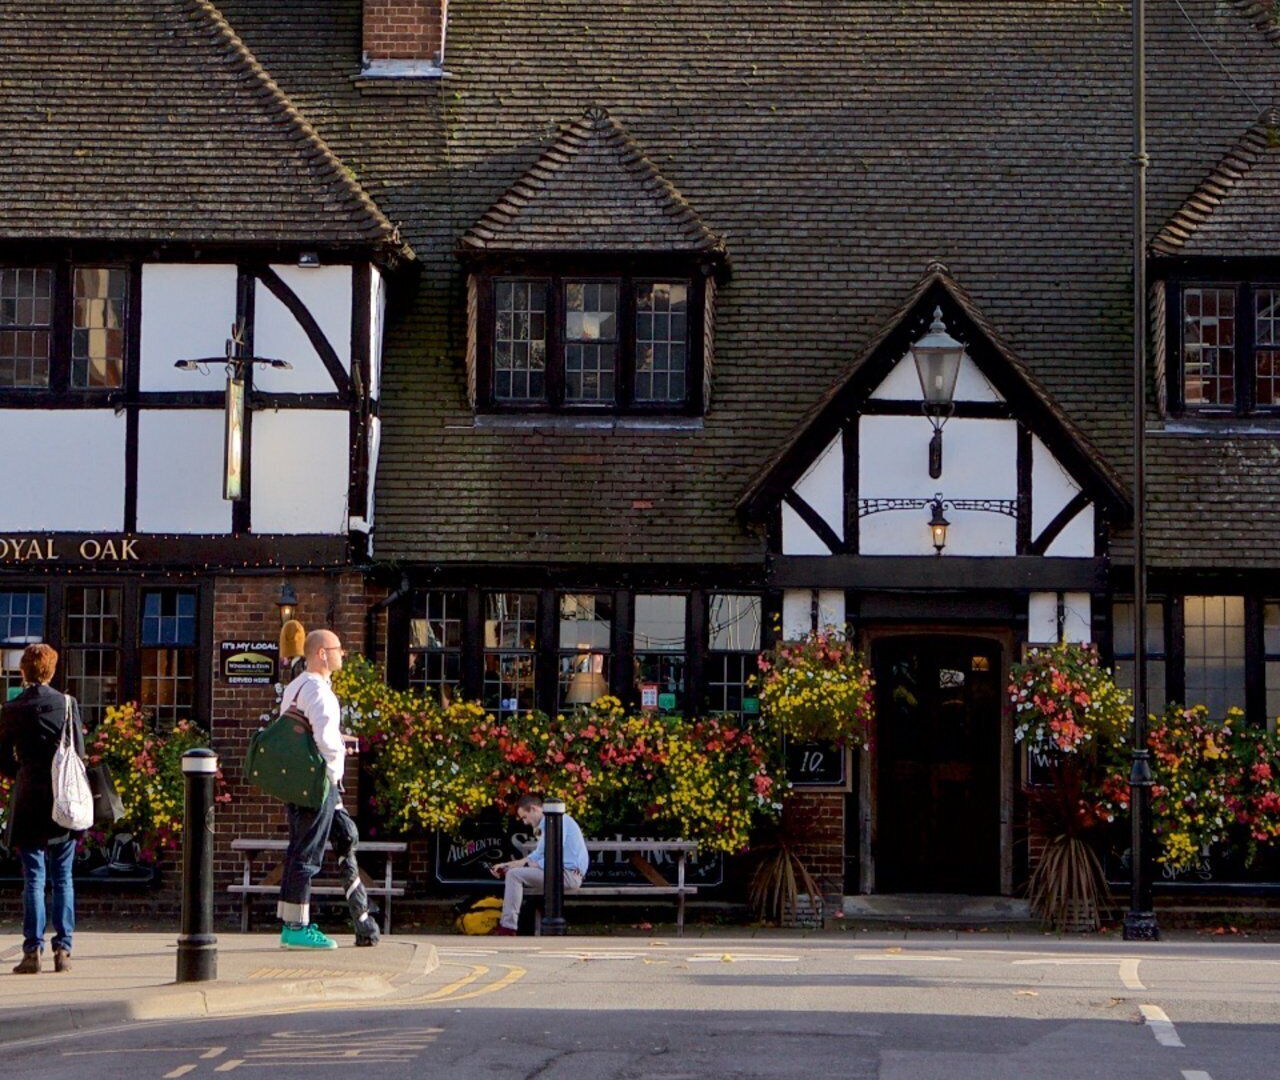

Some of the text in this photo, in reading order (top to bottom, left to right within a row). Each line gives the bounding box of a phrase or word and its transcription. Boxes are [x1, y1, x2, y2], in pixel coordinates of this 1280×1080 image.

[79, 539, 140, 560] OAK
[236, 642, 250, 652] MY
[251, 641, 278, 650] LOCAL
